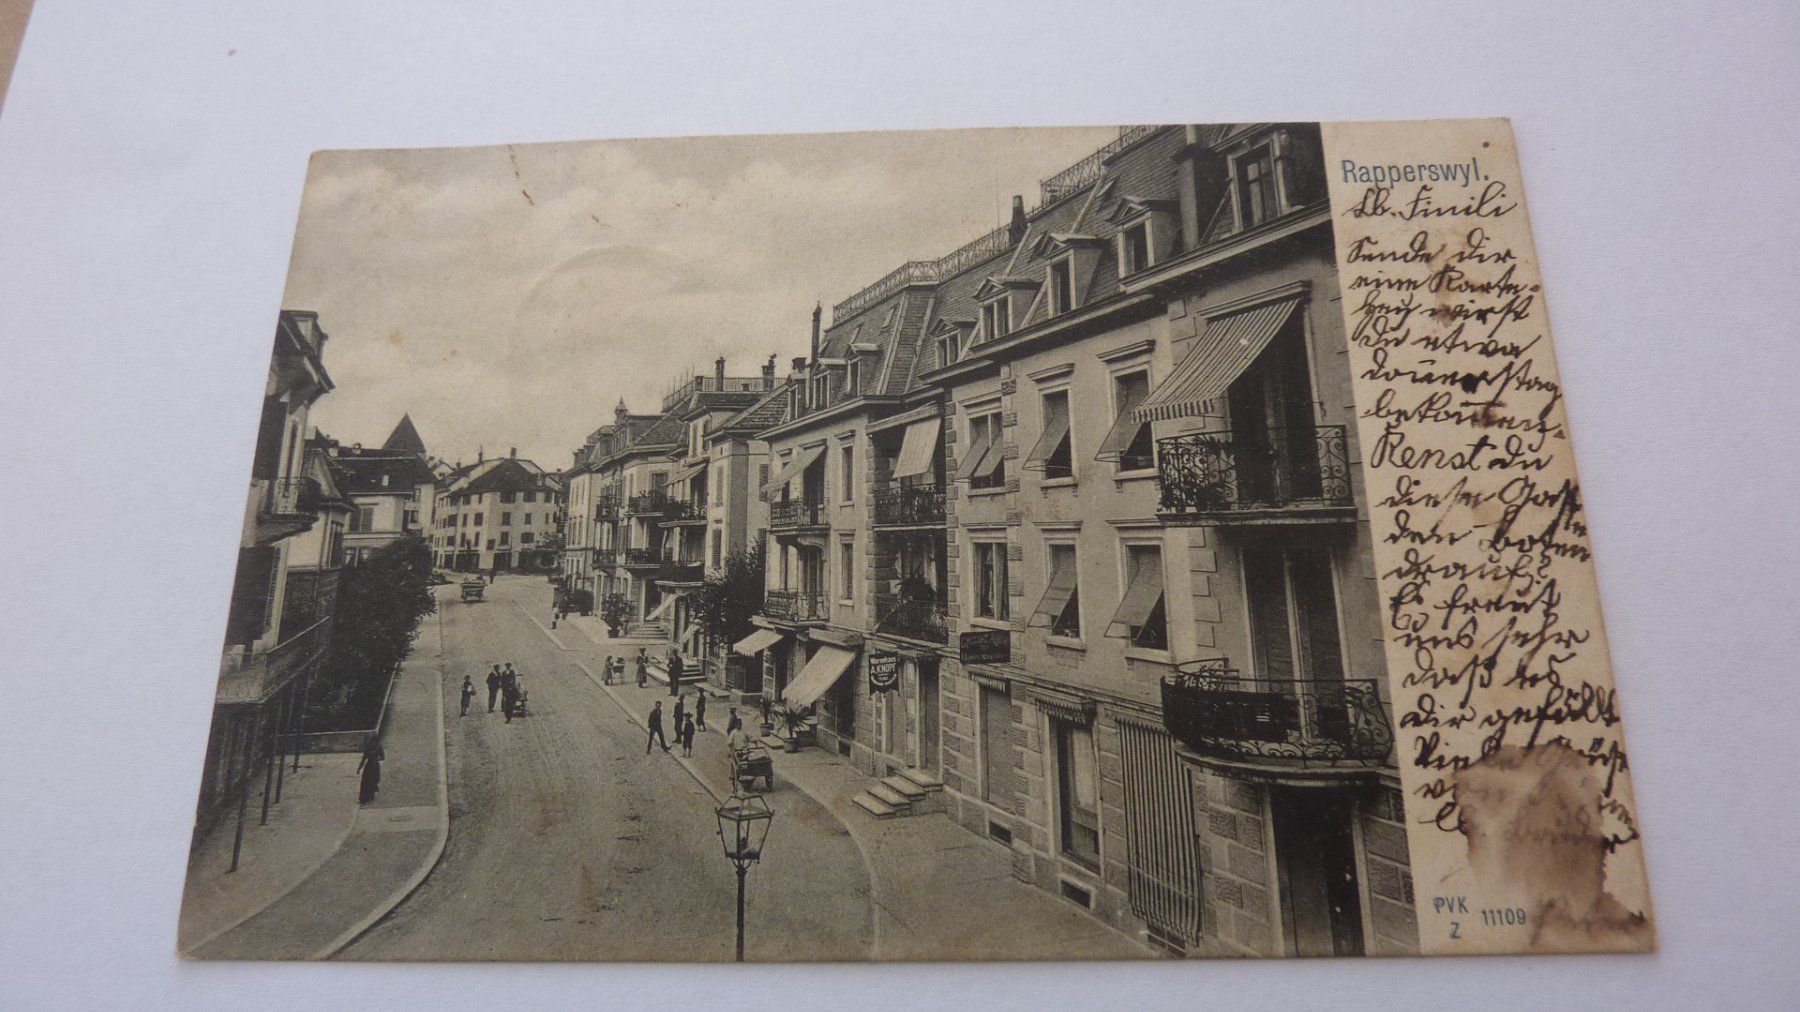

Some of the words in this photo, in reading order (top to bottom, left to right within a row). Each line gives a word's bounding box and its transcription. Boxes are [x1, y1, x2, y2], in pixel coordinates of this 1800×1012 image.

[1341, 156, 1489, 188] Rapperswyl.
[1433, 896, 1469, 914] PVK
[1481, 908, 1527, 926] 11109
[1449, 921, 1462, 939] Z
